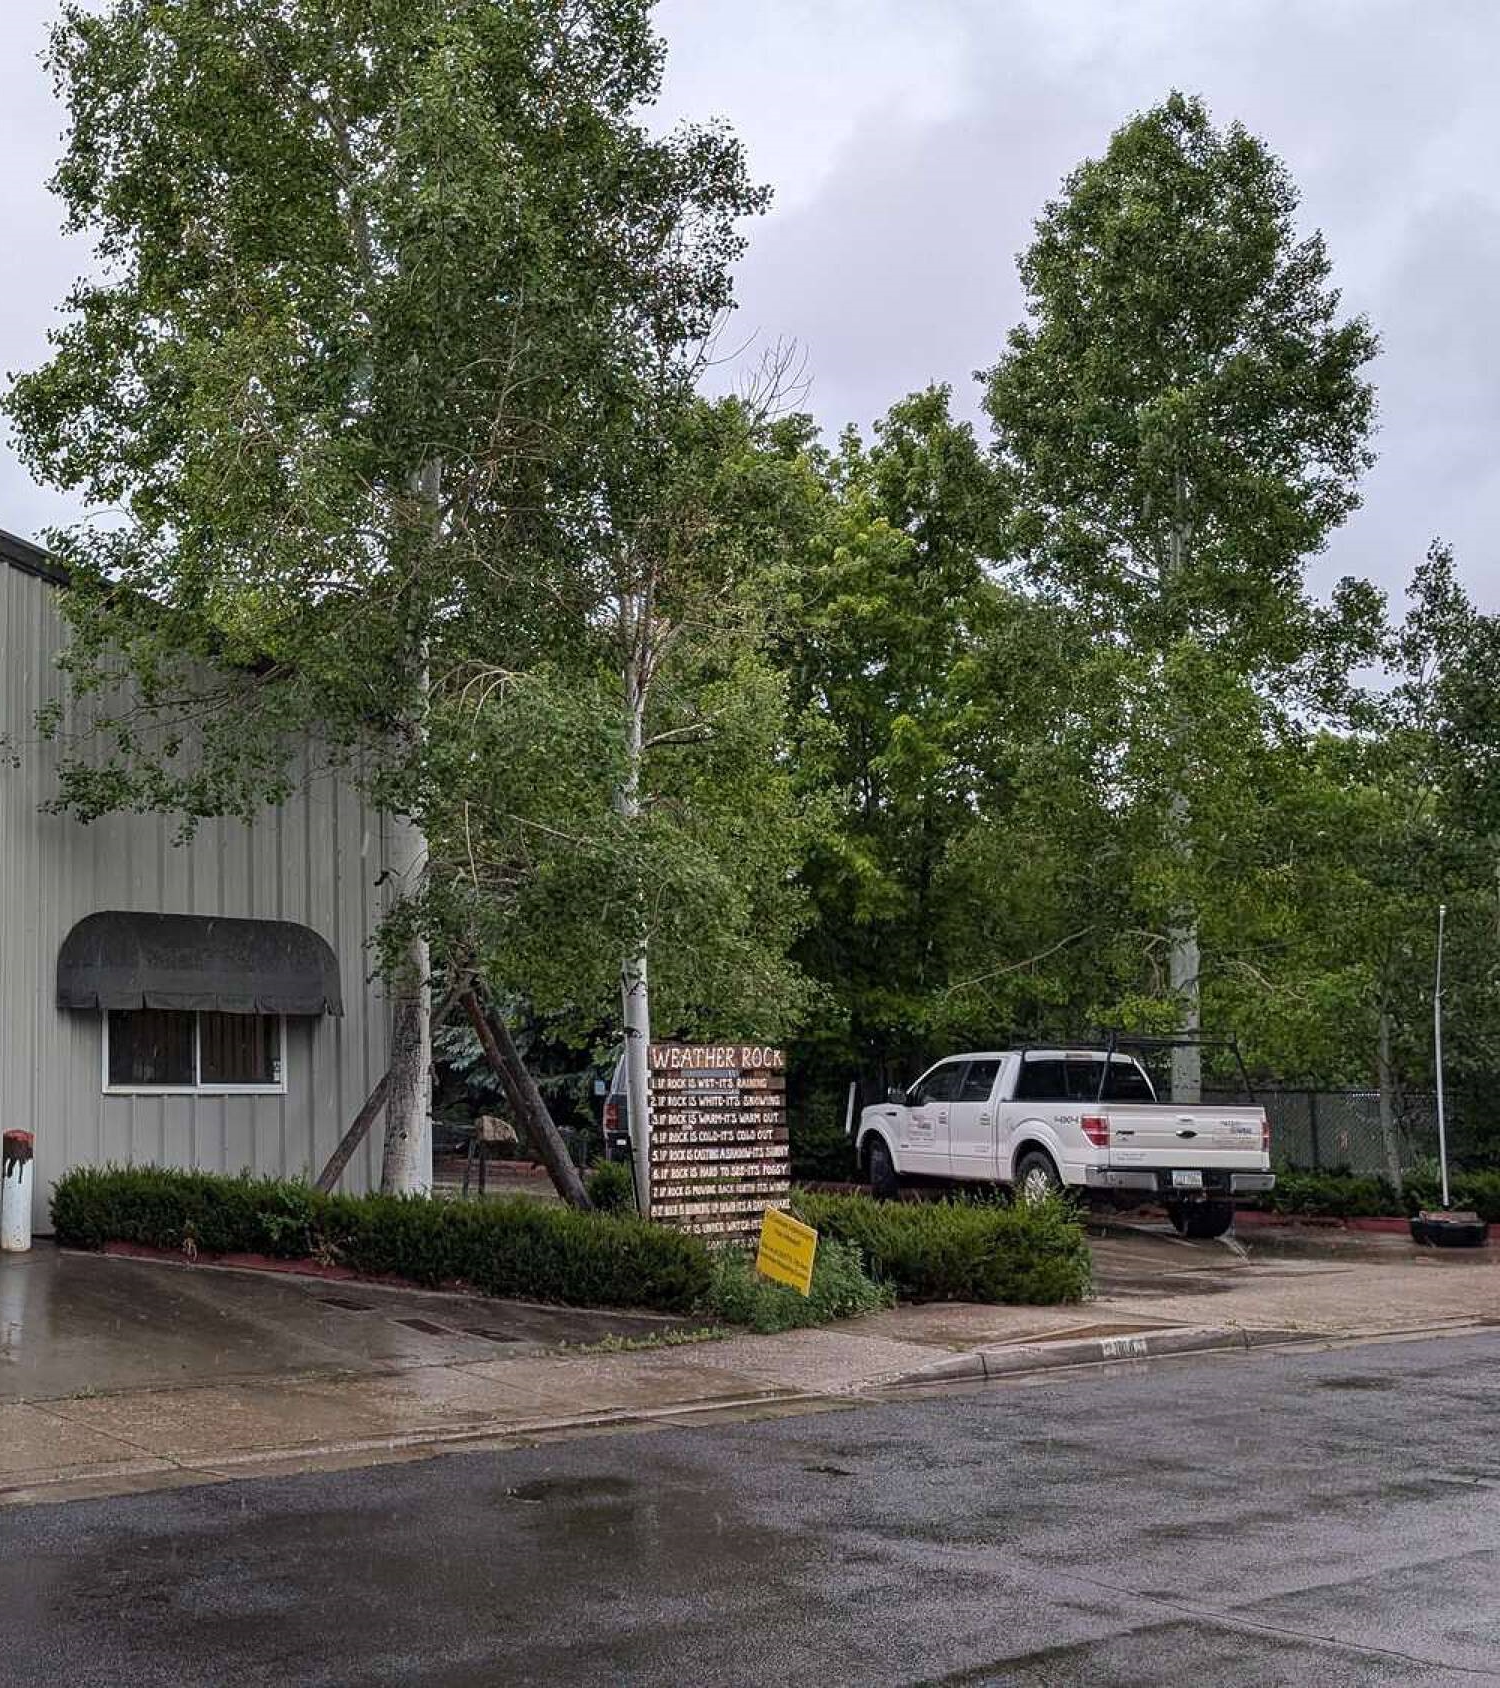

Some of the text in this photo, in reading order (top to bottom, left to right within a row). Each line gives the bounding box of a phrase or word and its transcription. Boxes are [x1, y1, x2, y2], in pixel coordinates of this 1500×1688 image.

[652, 1046, 784, 1068] WEATHER ROCK
[667, 1078, 687, 1089] ROCK
[688, 1078, 697, 1089] IS
[736, 1078, 768, 1089] RAINING
[668, 1096, 687, 1107] ROCK
[688, 1096, 697, 1107] IS
[743, 1095, 781, 1107] SNOWING
[668, 1114, 687, 1125] ROCK
[688, 1114, 697, 1125] IS
[740, 1112, 761, 1124] WARM
[763, 1112, 780, 1123] OUT
[668, 1132, 689, 1143] ROCK
[689, 1131, 698, 1142] IS
[736, 1130, 756, 1141] COLD
[757, 1129, 774, 1140] OUT
[669, 1149, 687, 1161] ROCK
[686, 1149, 694, 1160] IS
[671, 1168, 689, 1179] ROCK
[689, 1167, 698, 1178] IS
[700, 1166, 718, 1177] HARD
[720, 1166, 730, 1176] TO
[762, 1163, 788, 1175] FOGGY
